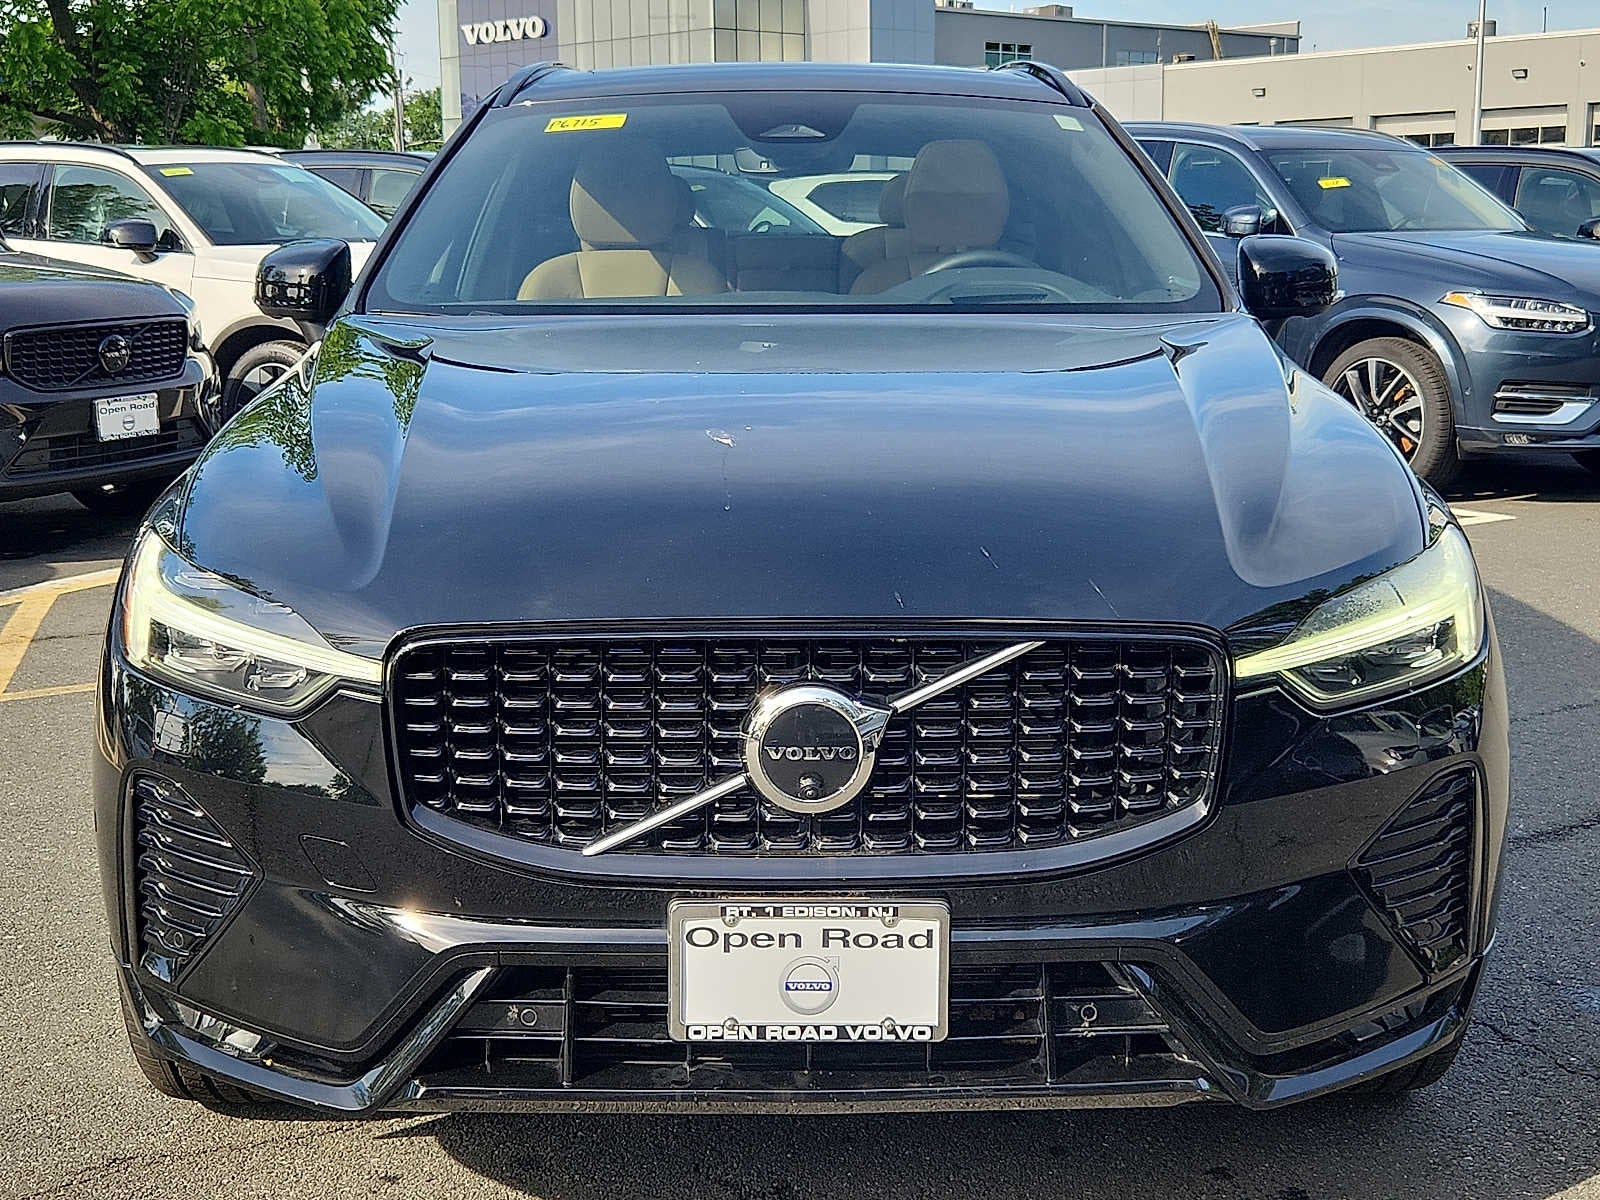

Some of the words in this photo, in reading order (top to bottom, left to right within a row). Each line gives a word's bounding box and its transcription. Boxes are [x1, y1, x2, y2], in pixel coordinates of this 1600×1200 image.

[461, 16, 544, 45] VOLVO
[100, 406, 126, 415] Open
[130, 401, 154, 410] Road
[764, 746, 857, 760] VOLVO
[765, 906, 774, 917] 1
[868, 906, 894, 917] NJ
[686, 927, 802, 953] Open
[822, 928, 934, 949] Road
[787, 982, 831, 990] VOLVO
[688, 1025, 757, 1040] OPEN
[765, 1025, 838, 1040] ROAD
[846, 1025, 931, 1040] VOLVO
